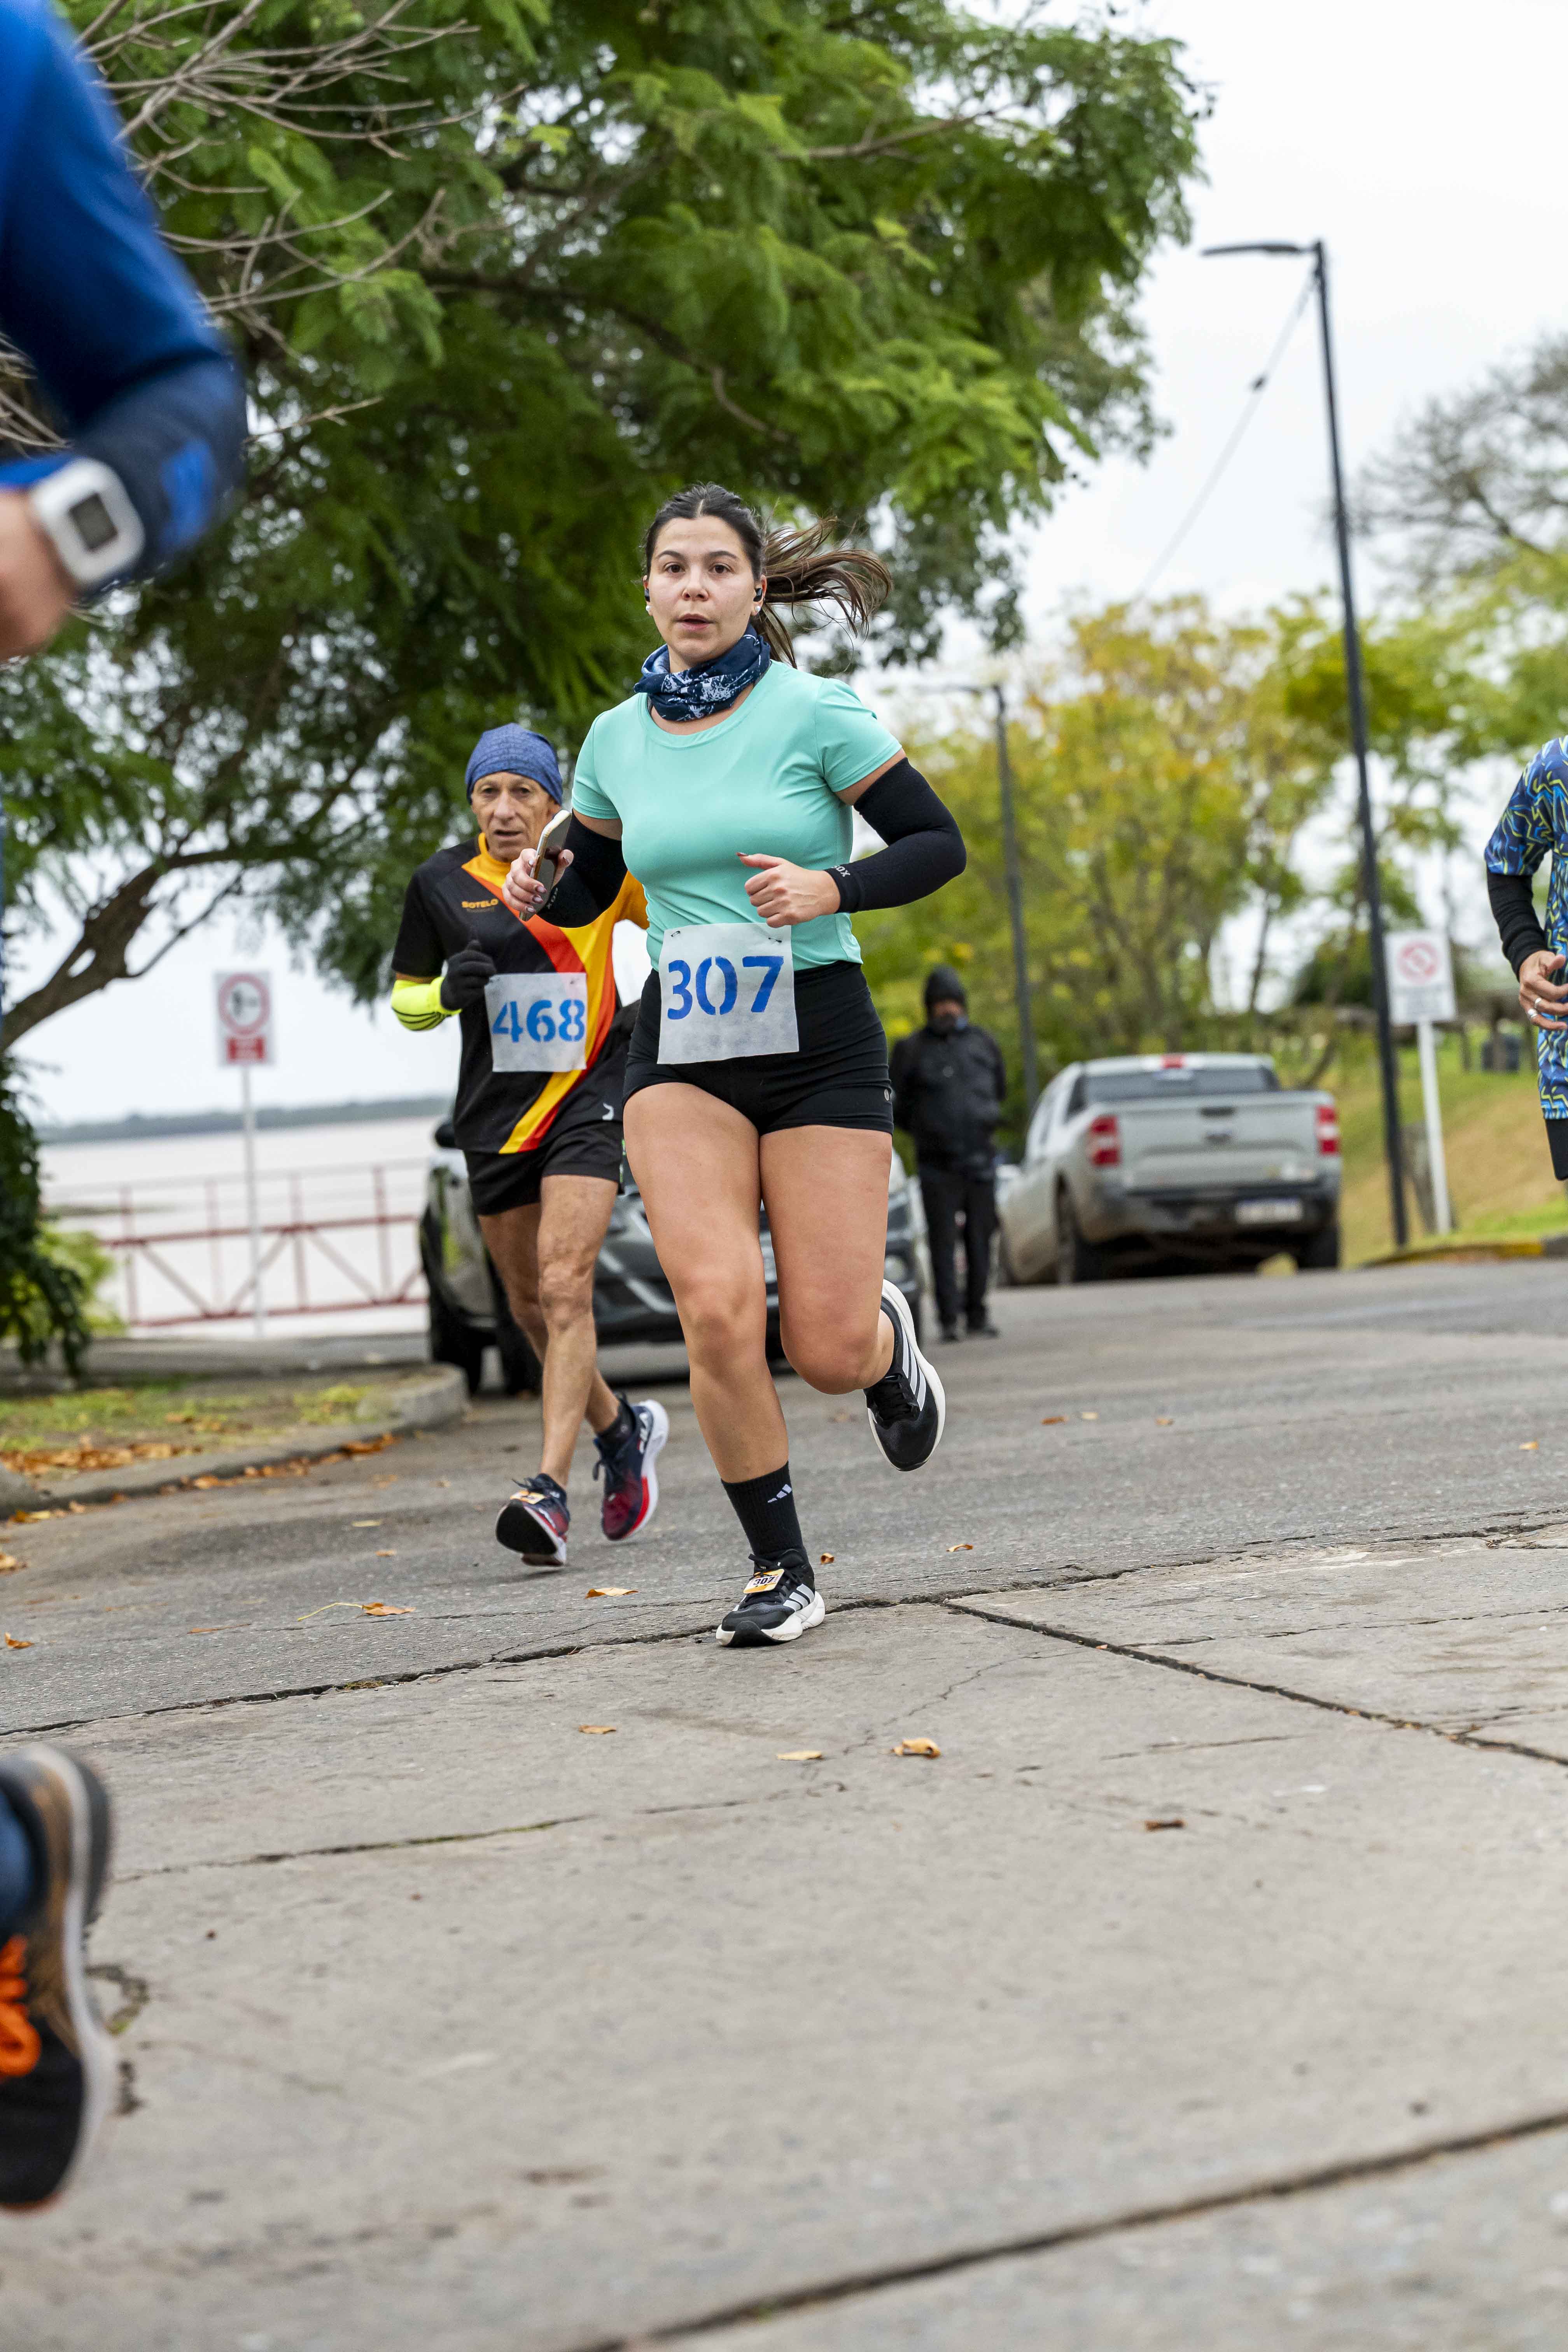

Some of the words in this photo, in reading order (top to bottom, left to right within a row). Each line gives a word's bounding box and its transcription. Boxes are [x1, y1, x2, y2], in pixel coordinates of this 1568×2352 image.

[462, 898, 499, 908] SOTELO
[667, 956, 784, 1020] 307
[492, 999, 585, 1043] 468
[753, 1577, 775, 1586] 307
